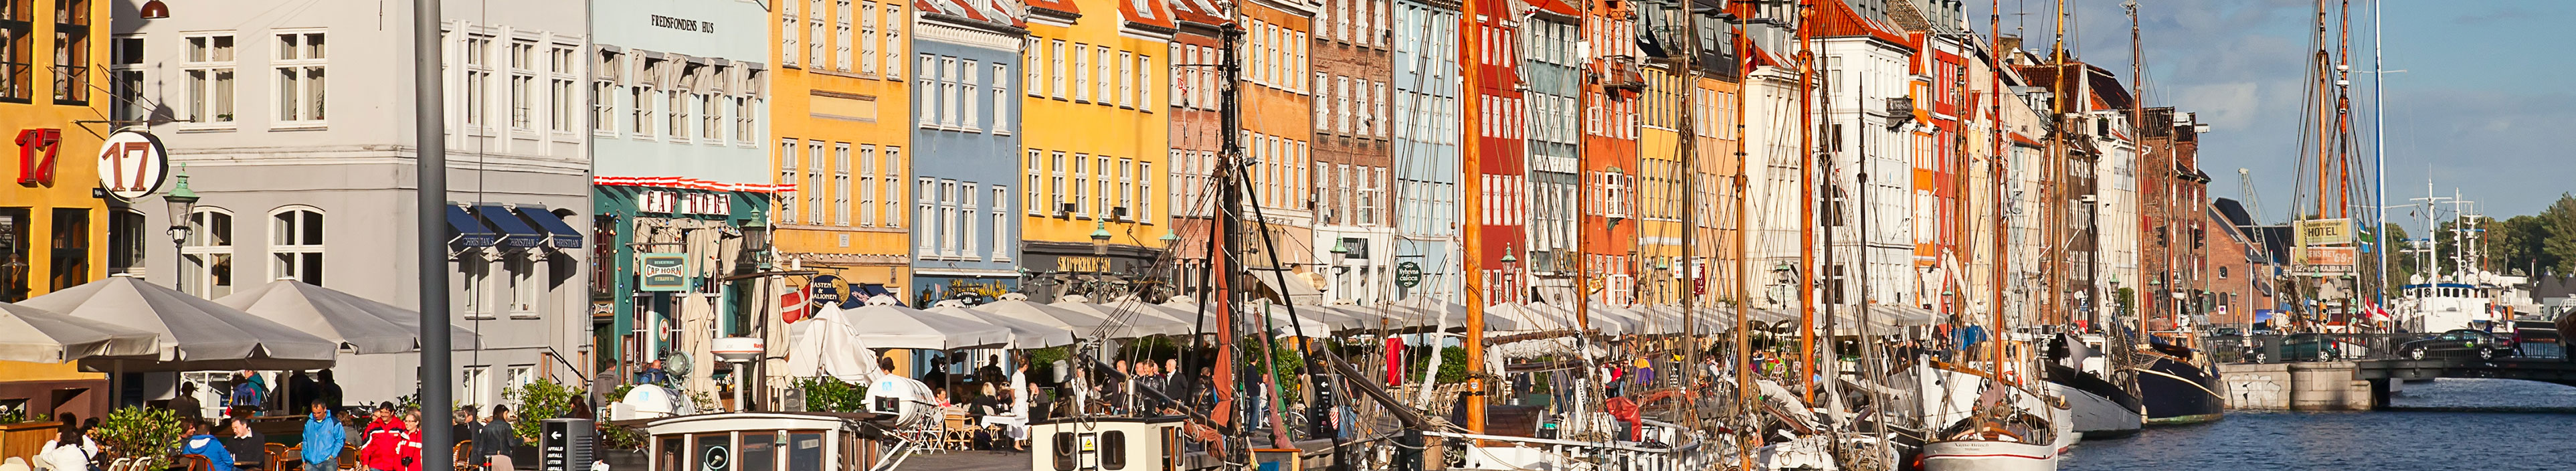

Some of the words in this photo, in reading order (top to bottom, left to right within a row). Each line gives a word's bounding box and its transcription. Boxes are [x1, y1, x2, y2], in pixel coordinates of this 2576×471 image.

[651, 14, 697, 31] FREDSFONDENS
[701, 21, 714, 33] HUS
[15, 128, 62, 186] 17
[102, 142, 151, 192] 17
[647, 191, 678, 213] CAP
[689, 192, 731, 215] HORN
[2308, 227, 2337, 237] HOTEL
[2323, 250, 2336, 258] RET
[647, 266, 660, 276] CAP
[661, 266, 681, 276] HORN
